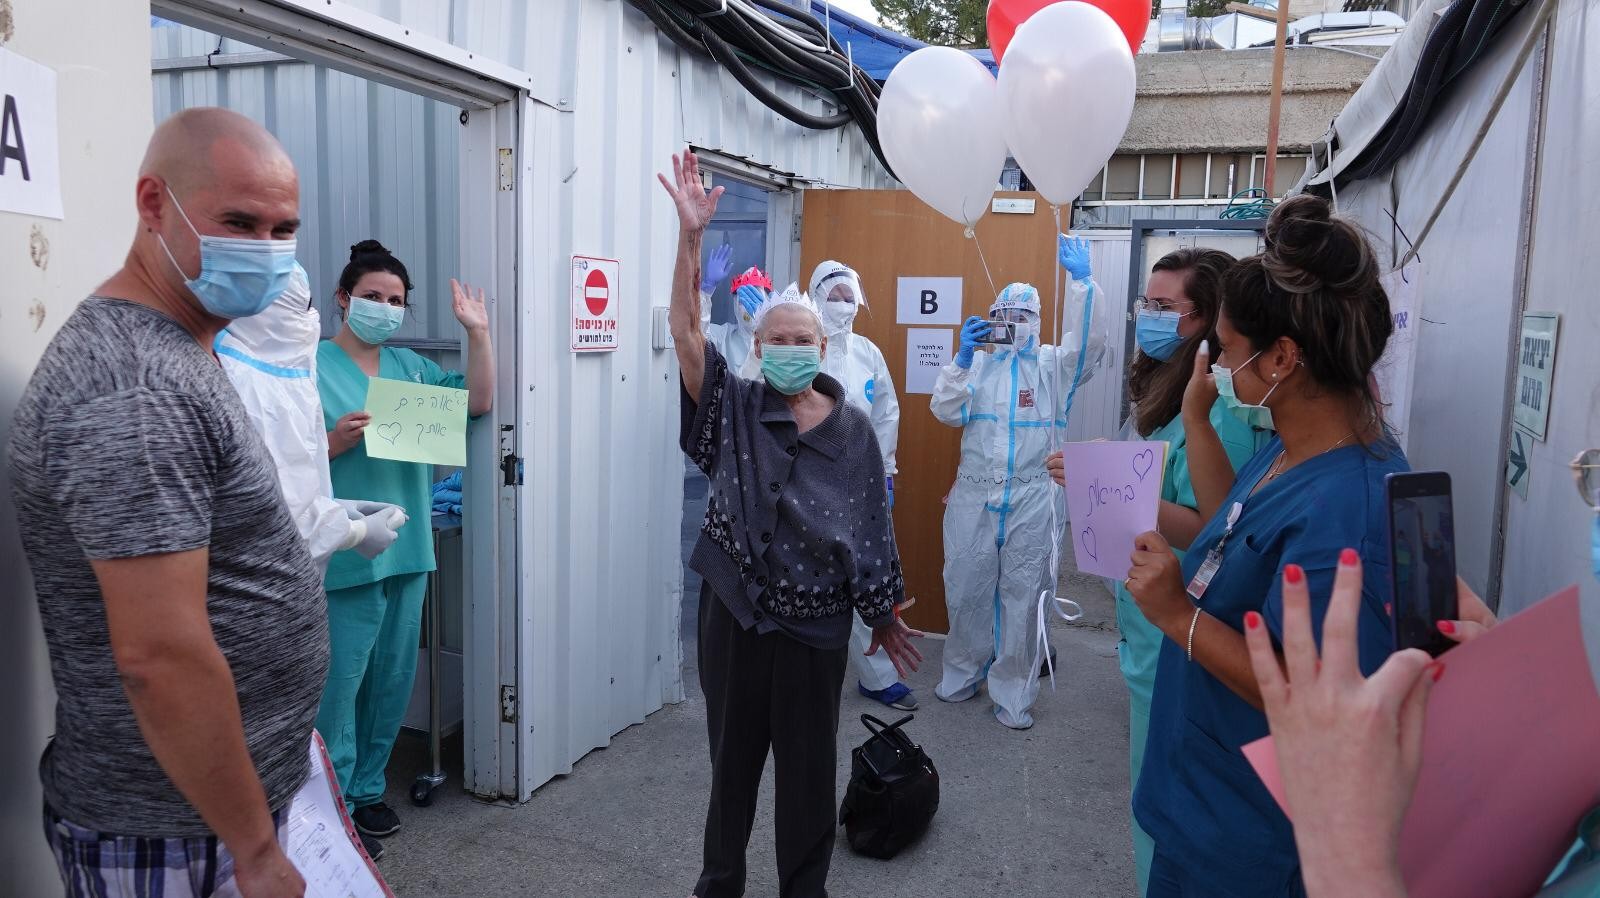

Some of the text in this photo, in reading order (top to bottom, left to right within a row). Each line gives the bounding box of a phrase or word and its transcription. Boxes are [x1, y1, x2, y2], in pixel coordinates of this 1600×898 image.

[0, 94, 31, 182] A
[920, 289, 939, 315] B
[575, 317, 616, 332] אין כניסה!
[602, 334, 613, 343] פרט
[1522, 336, 1551, 370] יציאת
[1086, 478, 1135, 518] בריאות
